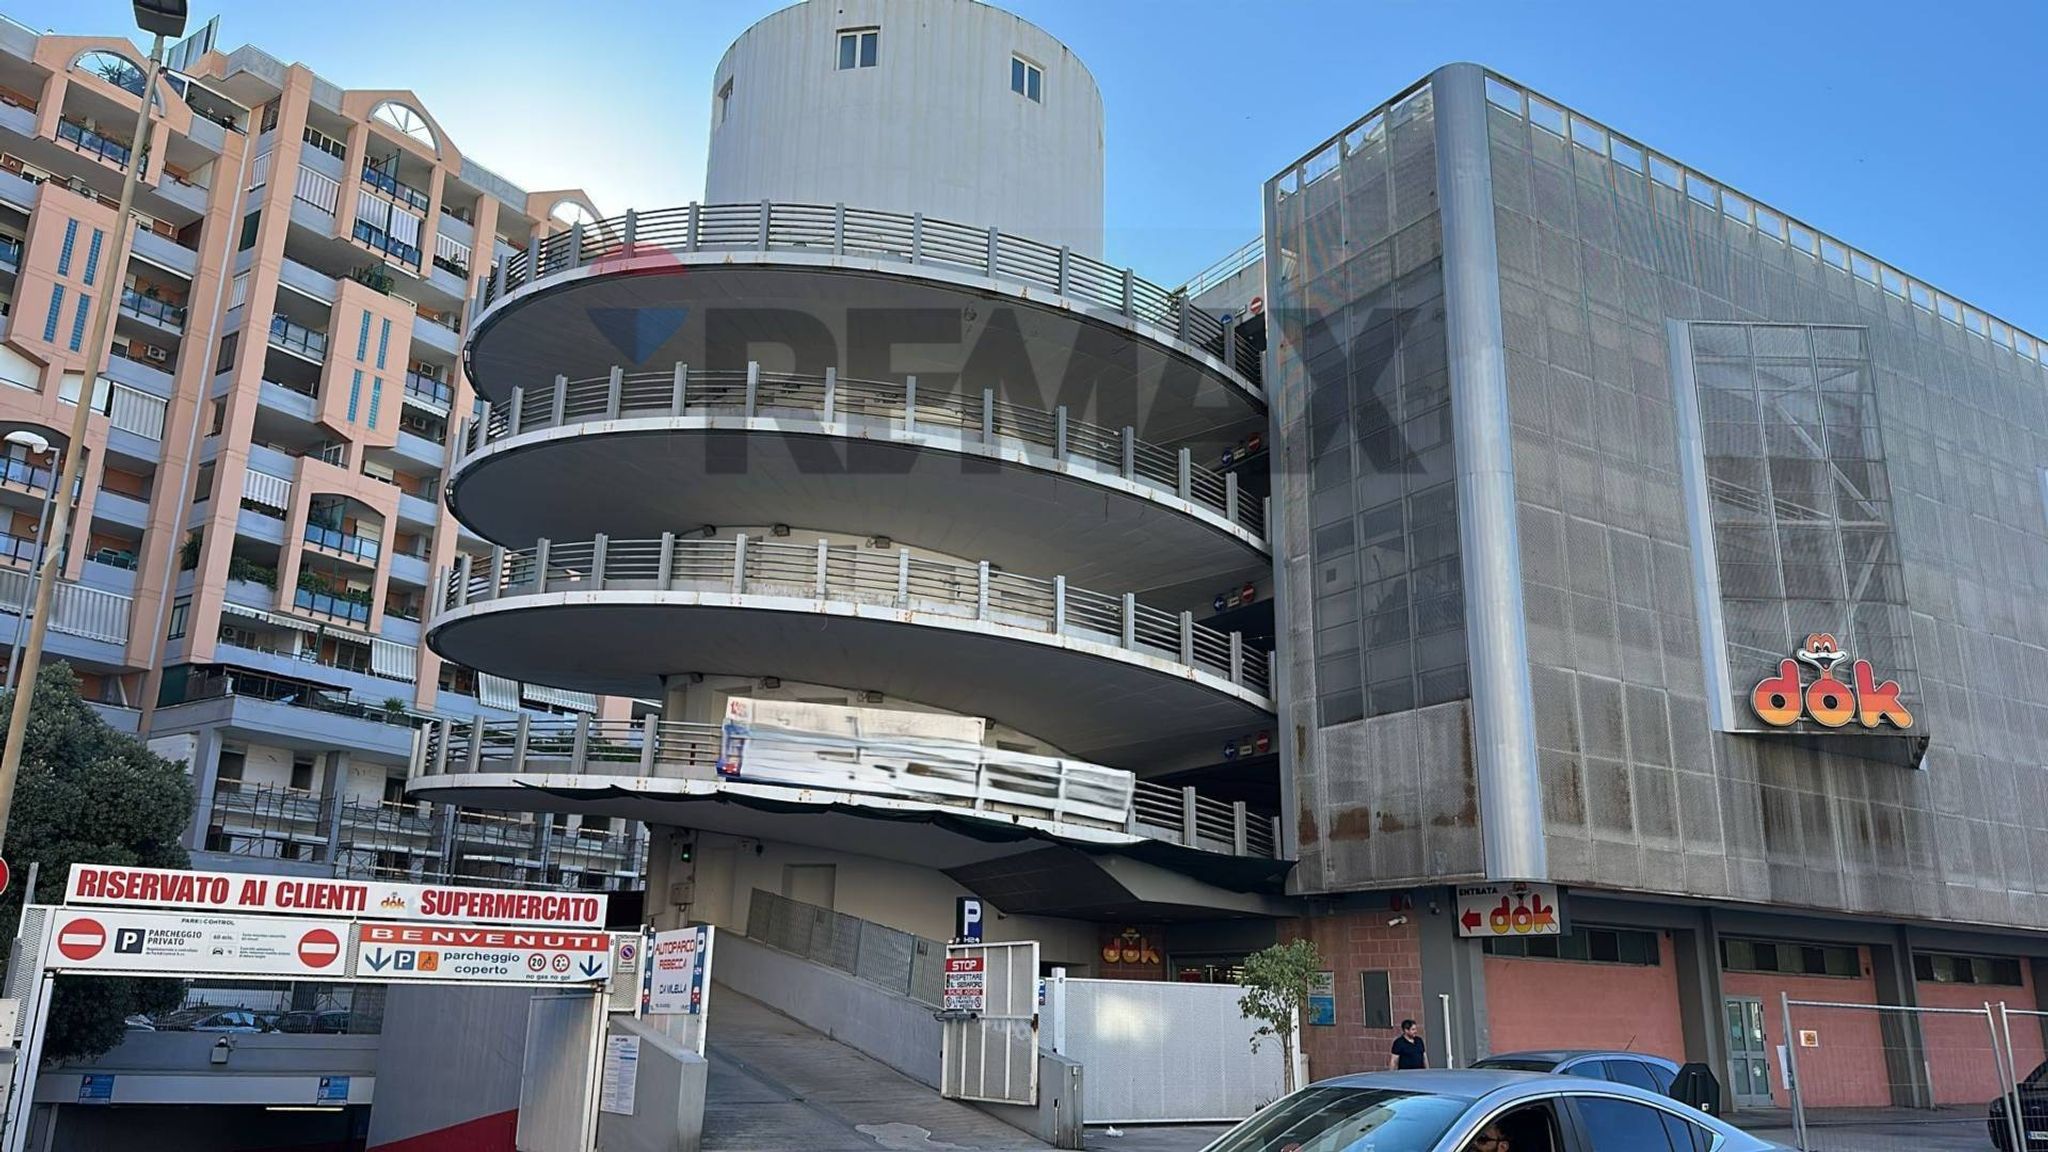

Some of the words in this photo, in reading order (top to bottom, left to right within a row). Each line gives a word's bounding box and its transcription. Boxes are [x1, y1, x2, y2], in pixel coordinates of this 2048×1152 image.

[1752, 658, 1914, 729] dok
[76, 869, 230, 904] RISERVATO
[239, 879, 268, 906] AI
[275, 881, 367, 911] CLIENTI
[420, 889, 598, 922] SUPERMERCATO
[1458, 886, 1498, 896] ENTRATA
[964, 900, 981, 936] P
[1489, 894, 1558, 934] dok
[148, 929, 202, 938] PARCHEGGIO
[371, 927, 599, 948] BENVENUTI
[122, 934, 138, 950] P
[147, 937, 185, 946] PRIVATO
[655, 939, 695, 955] AUTOPARCO
[398, 954, 411, 969] P
[444, 951, 520, 964] parcheggio
[532, 958, 543, 967] 20
[454, 964, 508, 976] coperto
[952, 960, 977, 971] STOP
[950, 973, 983, 981] RISPETTARE
